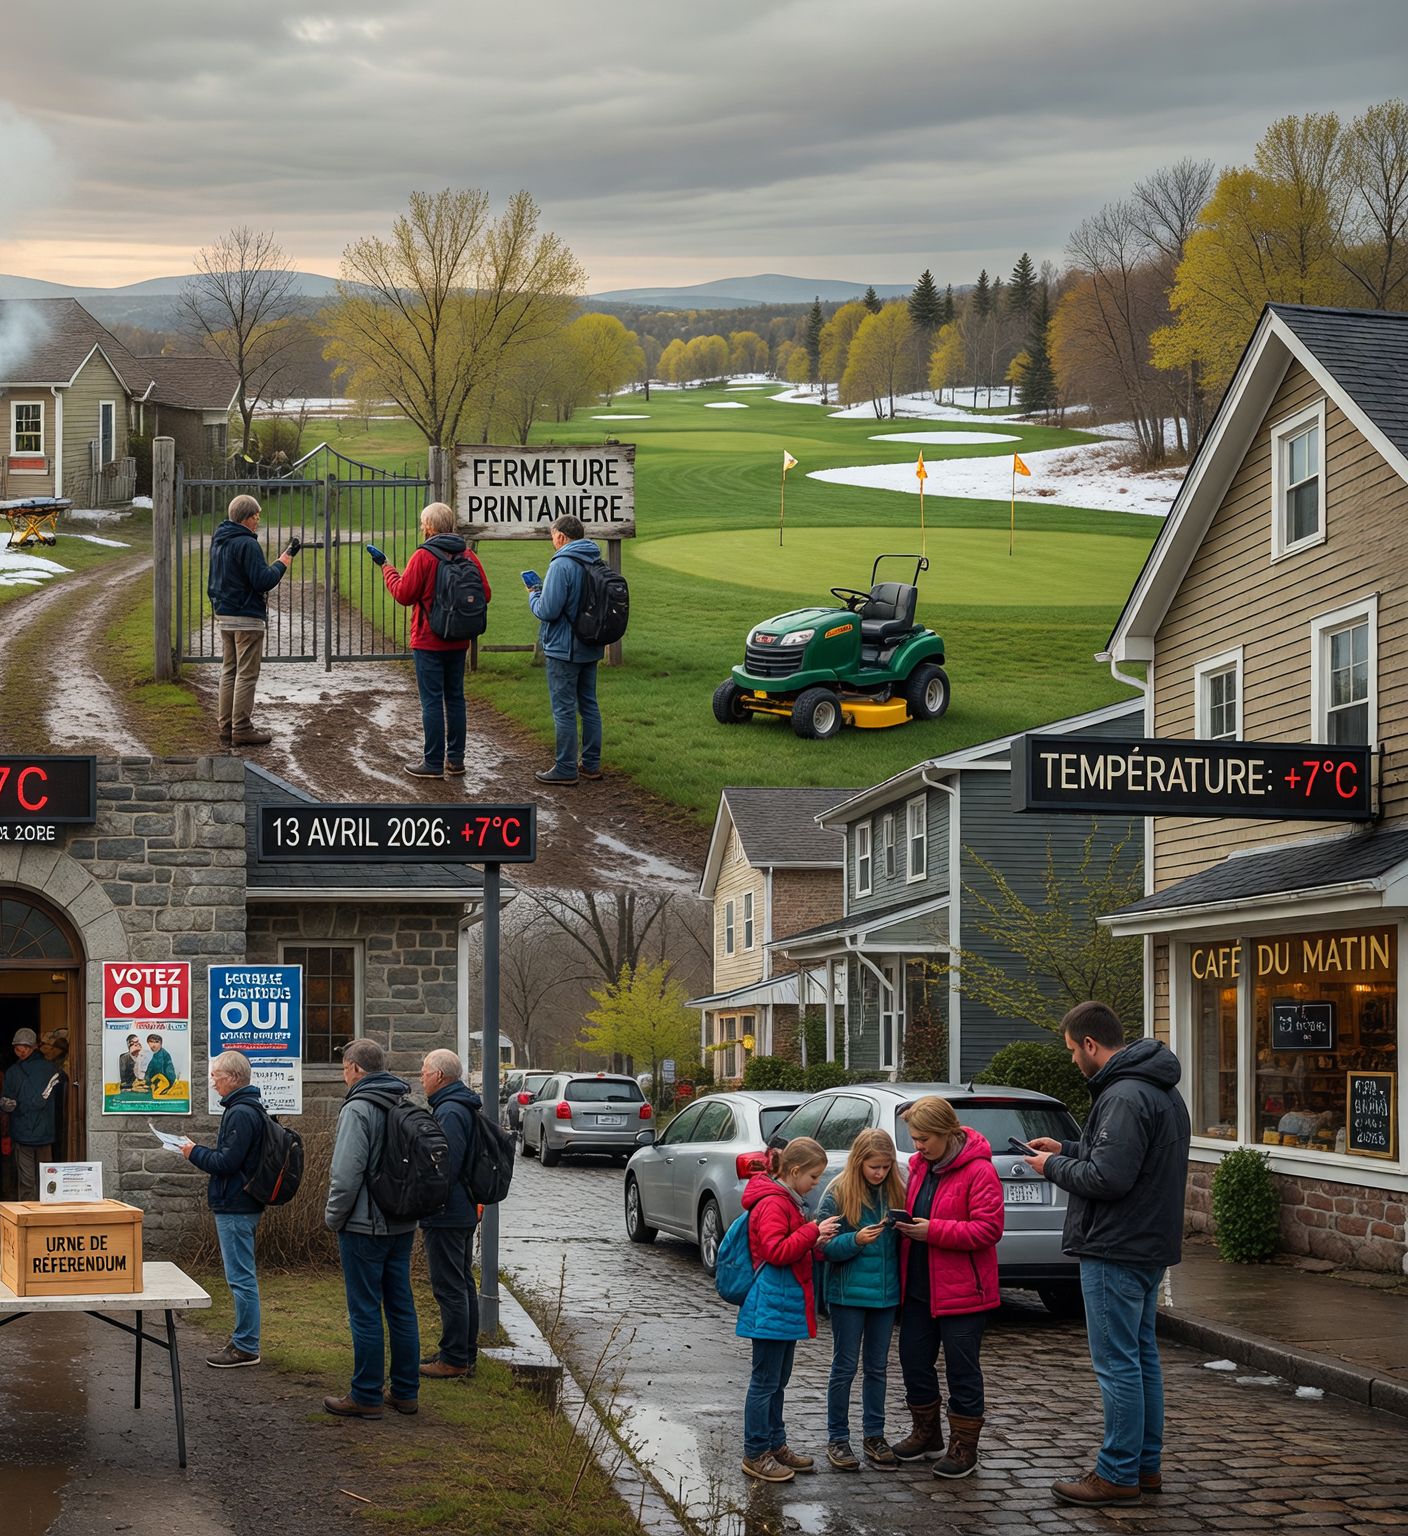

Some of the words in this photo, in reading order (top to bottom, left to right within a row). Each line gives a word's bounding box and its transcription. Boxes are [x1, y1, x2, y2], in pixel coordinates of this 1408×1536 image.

[473, 458, 619, 487] FERMETURE
[468, 489, 624, 523] PRINTANIÈRE
[1039, 746, 1273, 795] TEMPÉRATURE:
[1284, 760, 1358, 799] +7°C
[272, 817, 300, 847] 13
[307, 817, 379, 847] AVRIL
[387, 817, 452, 847] 2026:
[461, 816, 521, 847] +7°C
[1192, 940, 1242, 979] CAFÉ
[1258, 942, 1289, 976] DU
[1303, 934, 1389, 973] MATIN
[110, 968, 182, 985] VOTEZ
[113, 986, 180, 1014] OUI
[220, 1001, 289, 1030] OUI
[46, 1235, 85, 1253] URNE
[90, 1234, 108, 1251] DE
